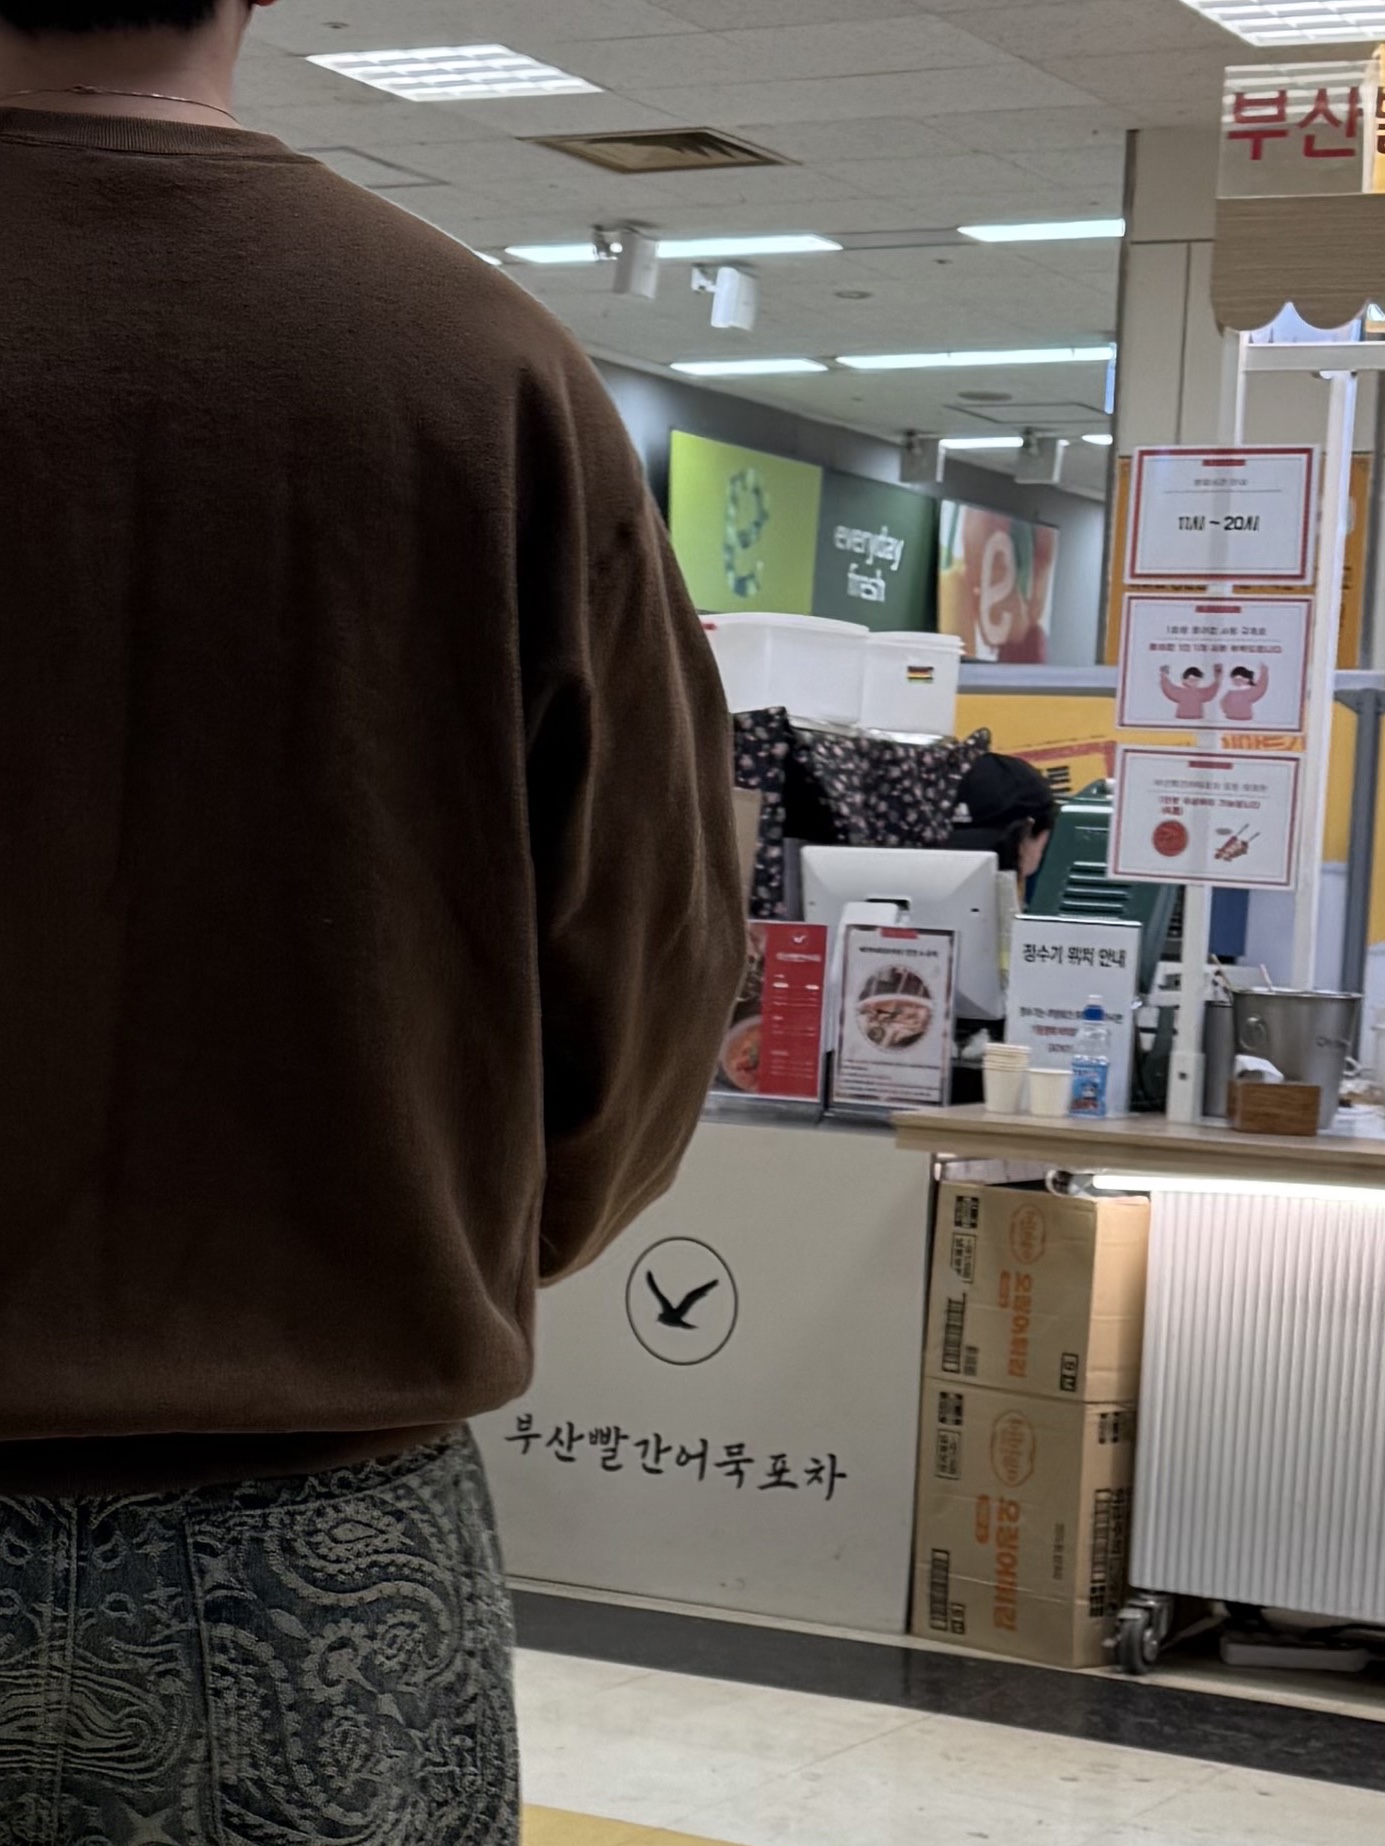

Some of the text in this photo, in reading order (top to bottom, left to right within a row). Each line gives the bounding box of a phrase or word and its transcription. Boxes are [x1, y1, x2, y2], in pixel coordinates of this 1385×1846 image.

[1228, 86, 1364, 161] 부산
[1224, 515, 1260, 531] 20시
[834, 525, 905, 571] everyday
[847, 563, 886, 602] fresh
[1023, 943, 1064, 964] 정수기
[1098, 949, 1128, 969] 안내
[505, 1413, 847, 1501] 부산빨간어묵포차
